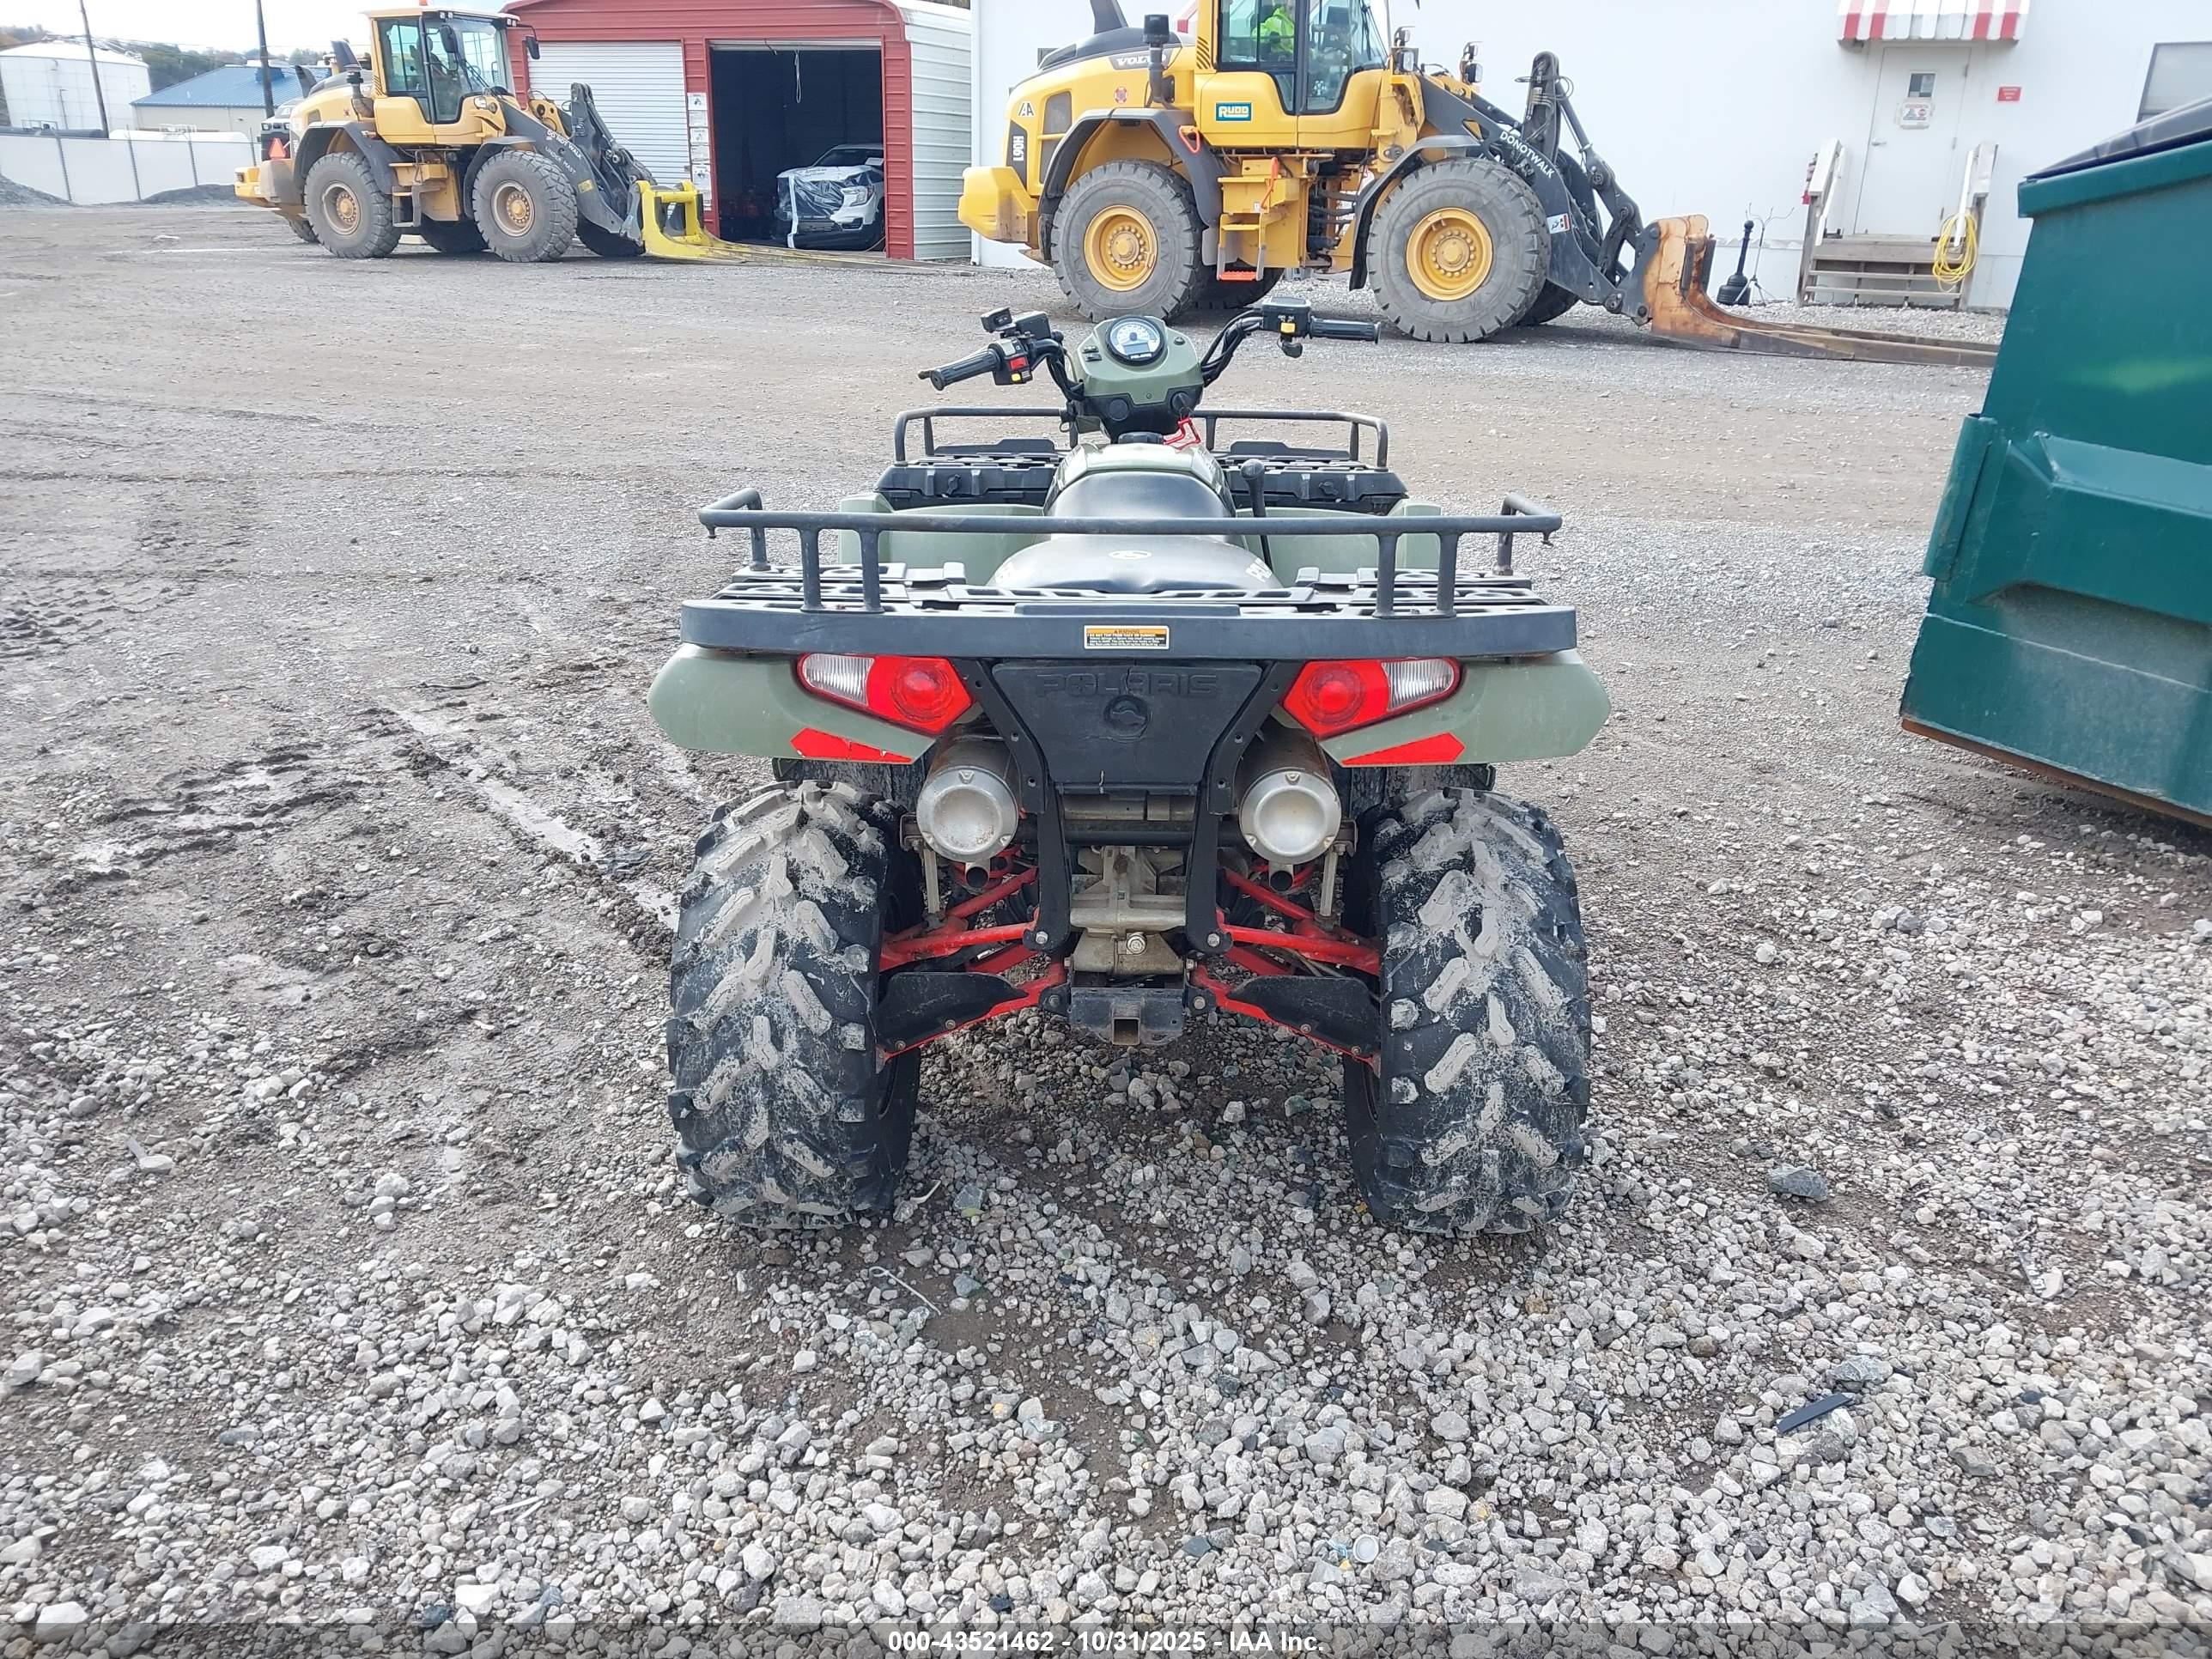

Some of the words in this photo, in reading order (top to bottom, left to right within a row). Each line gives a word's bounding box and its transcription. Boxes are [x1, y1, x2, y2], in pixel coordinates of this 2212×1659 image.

[1218, 106, 1249, 118] RUDD
[568, 143, 582, 161] WALK
[1012, 136, 1024, 161] L90H
[1037, 672, 1217, 696] POLARIS
